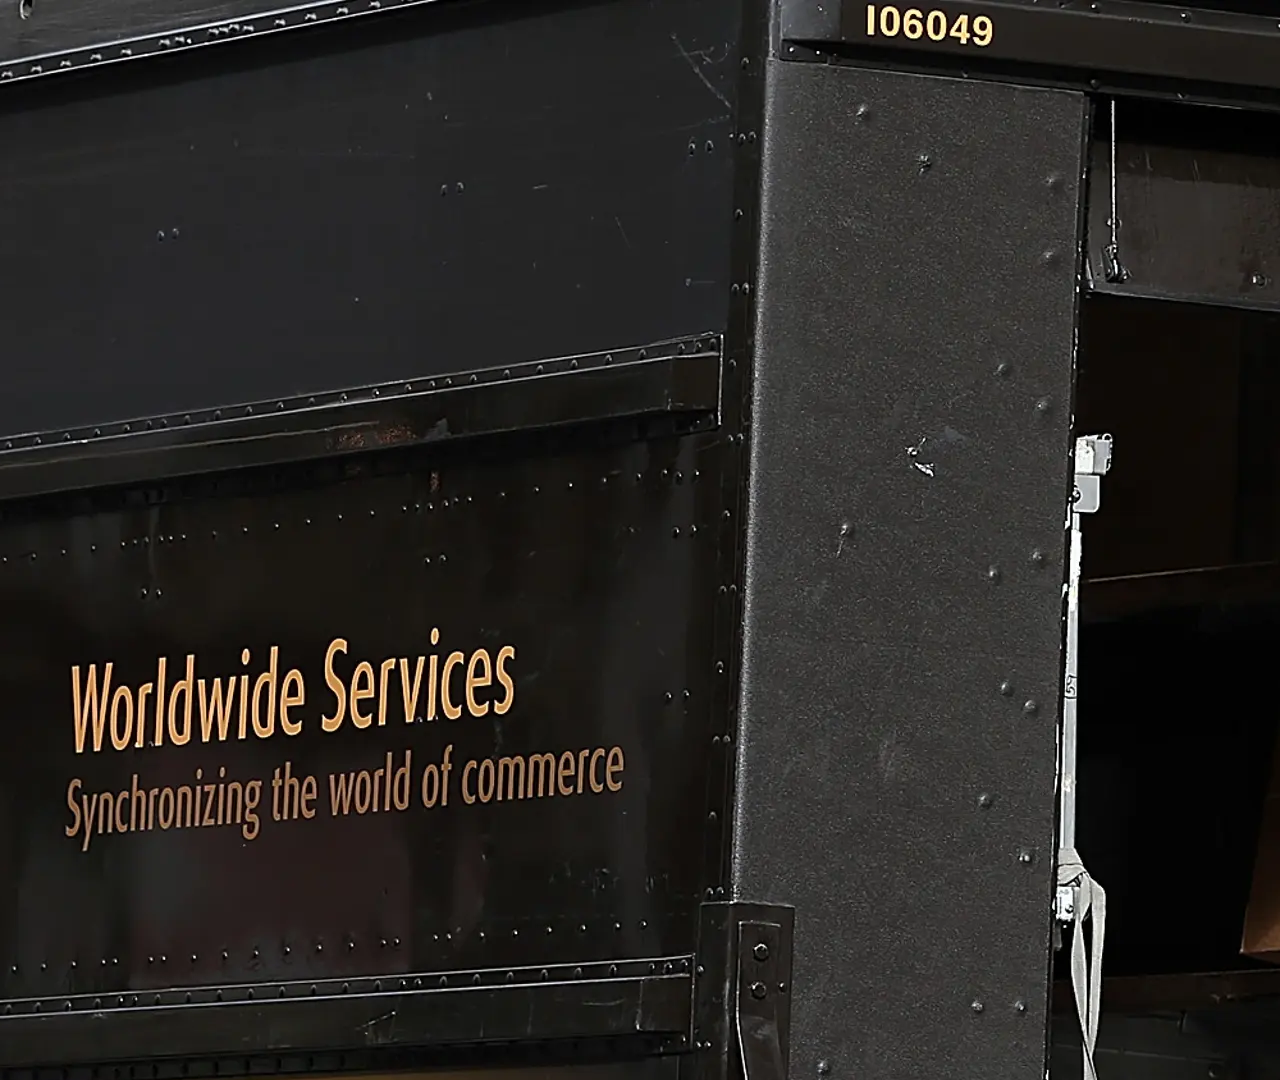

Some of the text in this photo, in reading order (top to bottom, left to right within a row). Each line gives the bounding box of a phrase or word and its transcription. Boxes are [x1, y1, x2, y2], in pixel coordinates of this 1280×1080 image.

[71, 627, 516, 753] Worldwide Services
[65, 744, 626, 852] Synchronizing the world of commerce
